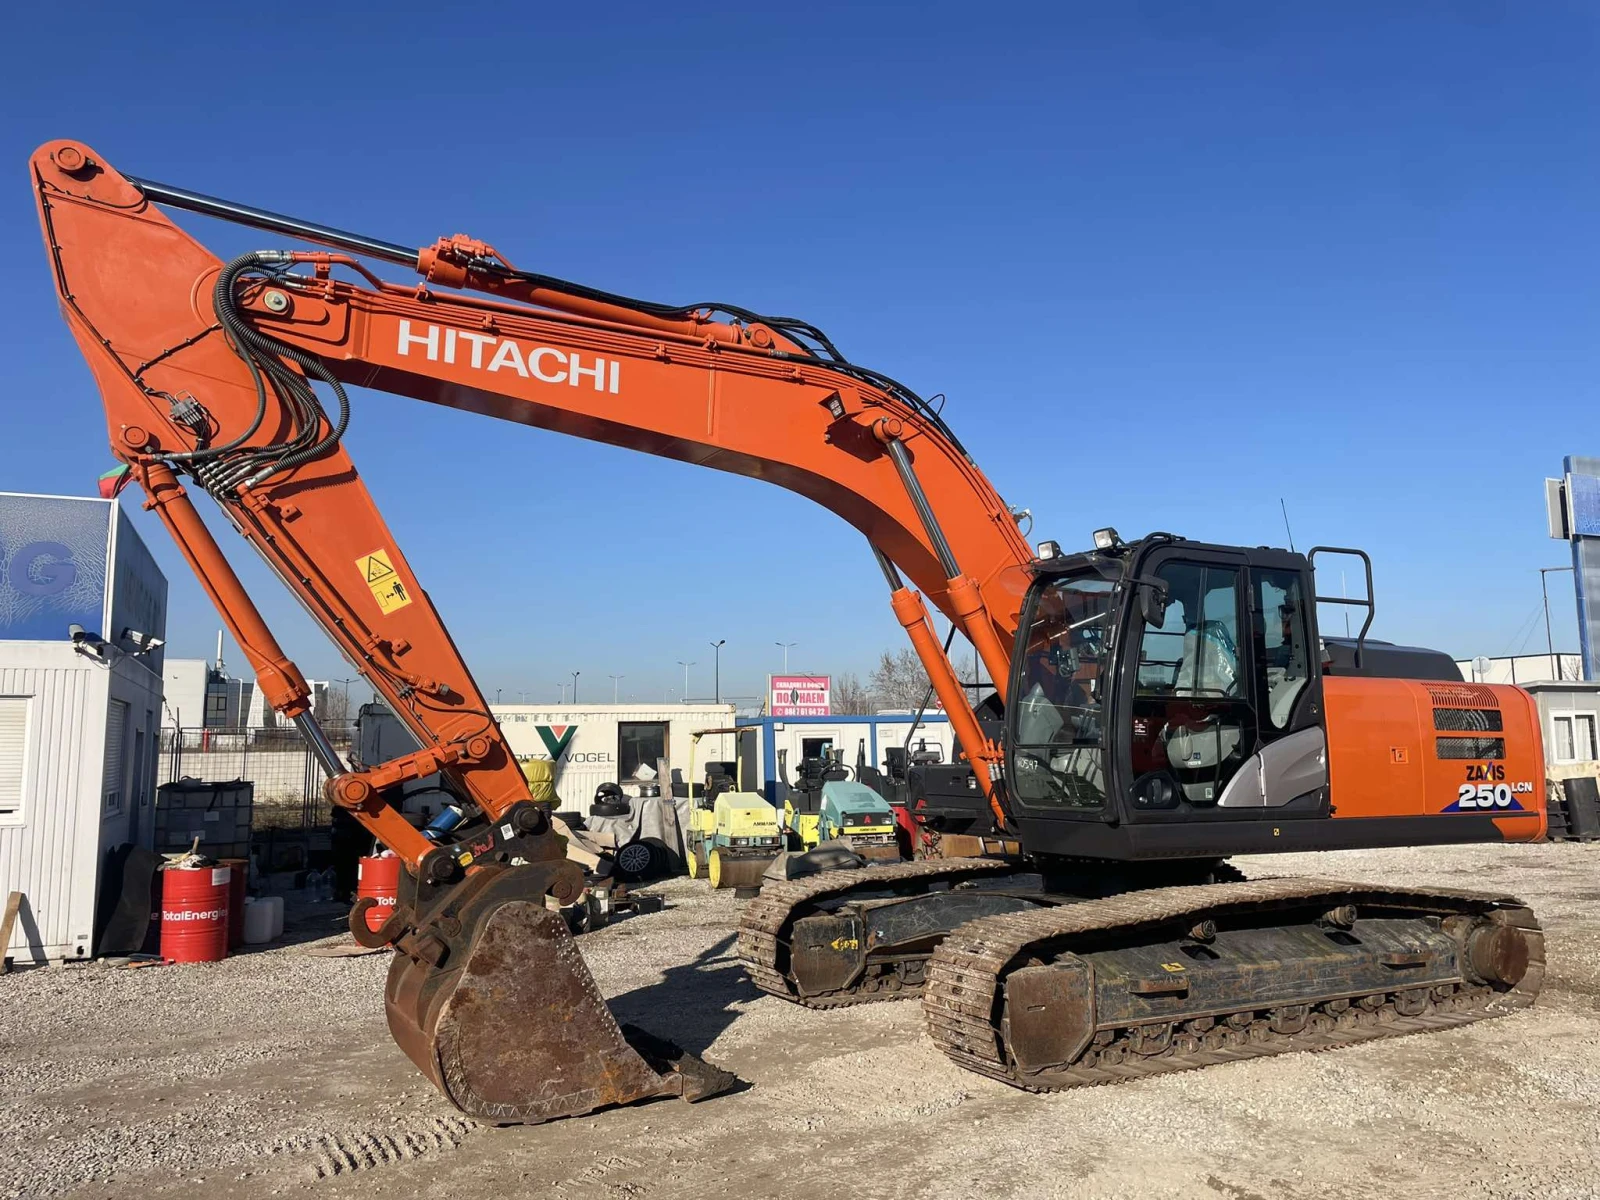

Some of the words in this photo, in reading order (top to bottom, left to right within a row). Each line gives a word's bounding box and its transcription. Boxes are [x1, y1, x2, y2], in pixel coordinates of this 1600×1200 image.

[397, 319, 620, 394] HITACHI
[0, 537, 77, 597] G
[799, 692, 825, 704] НАЕМ
[564, 752, 615, 763] VOGEL
[1466, 762, 1505, 781] ZAXIS
[1458, 783, 1512, 808] 250
[1511, 782, 1533, 793] LCN
